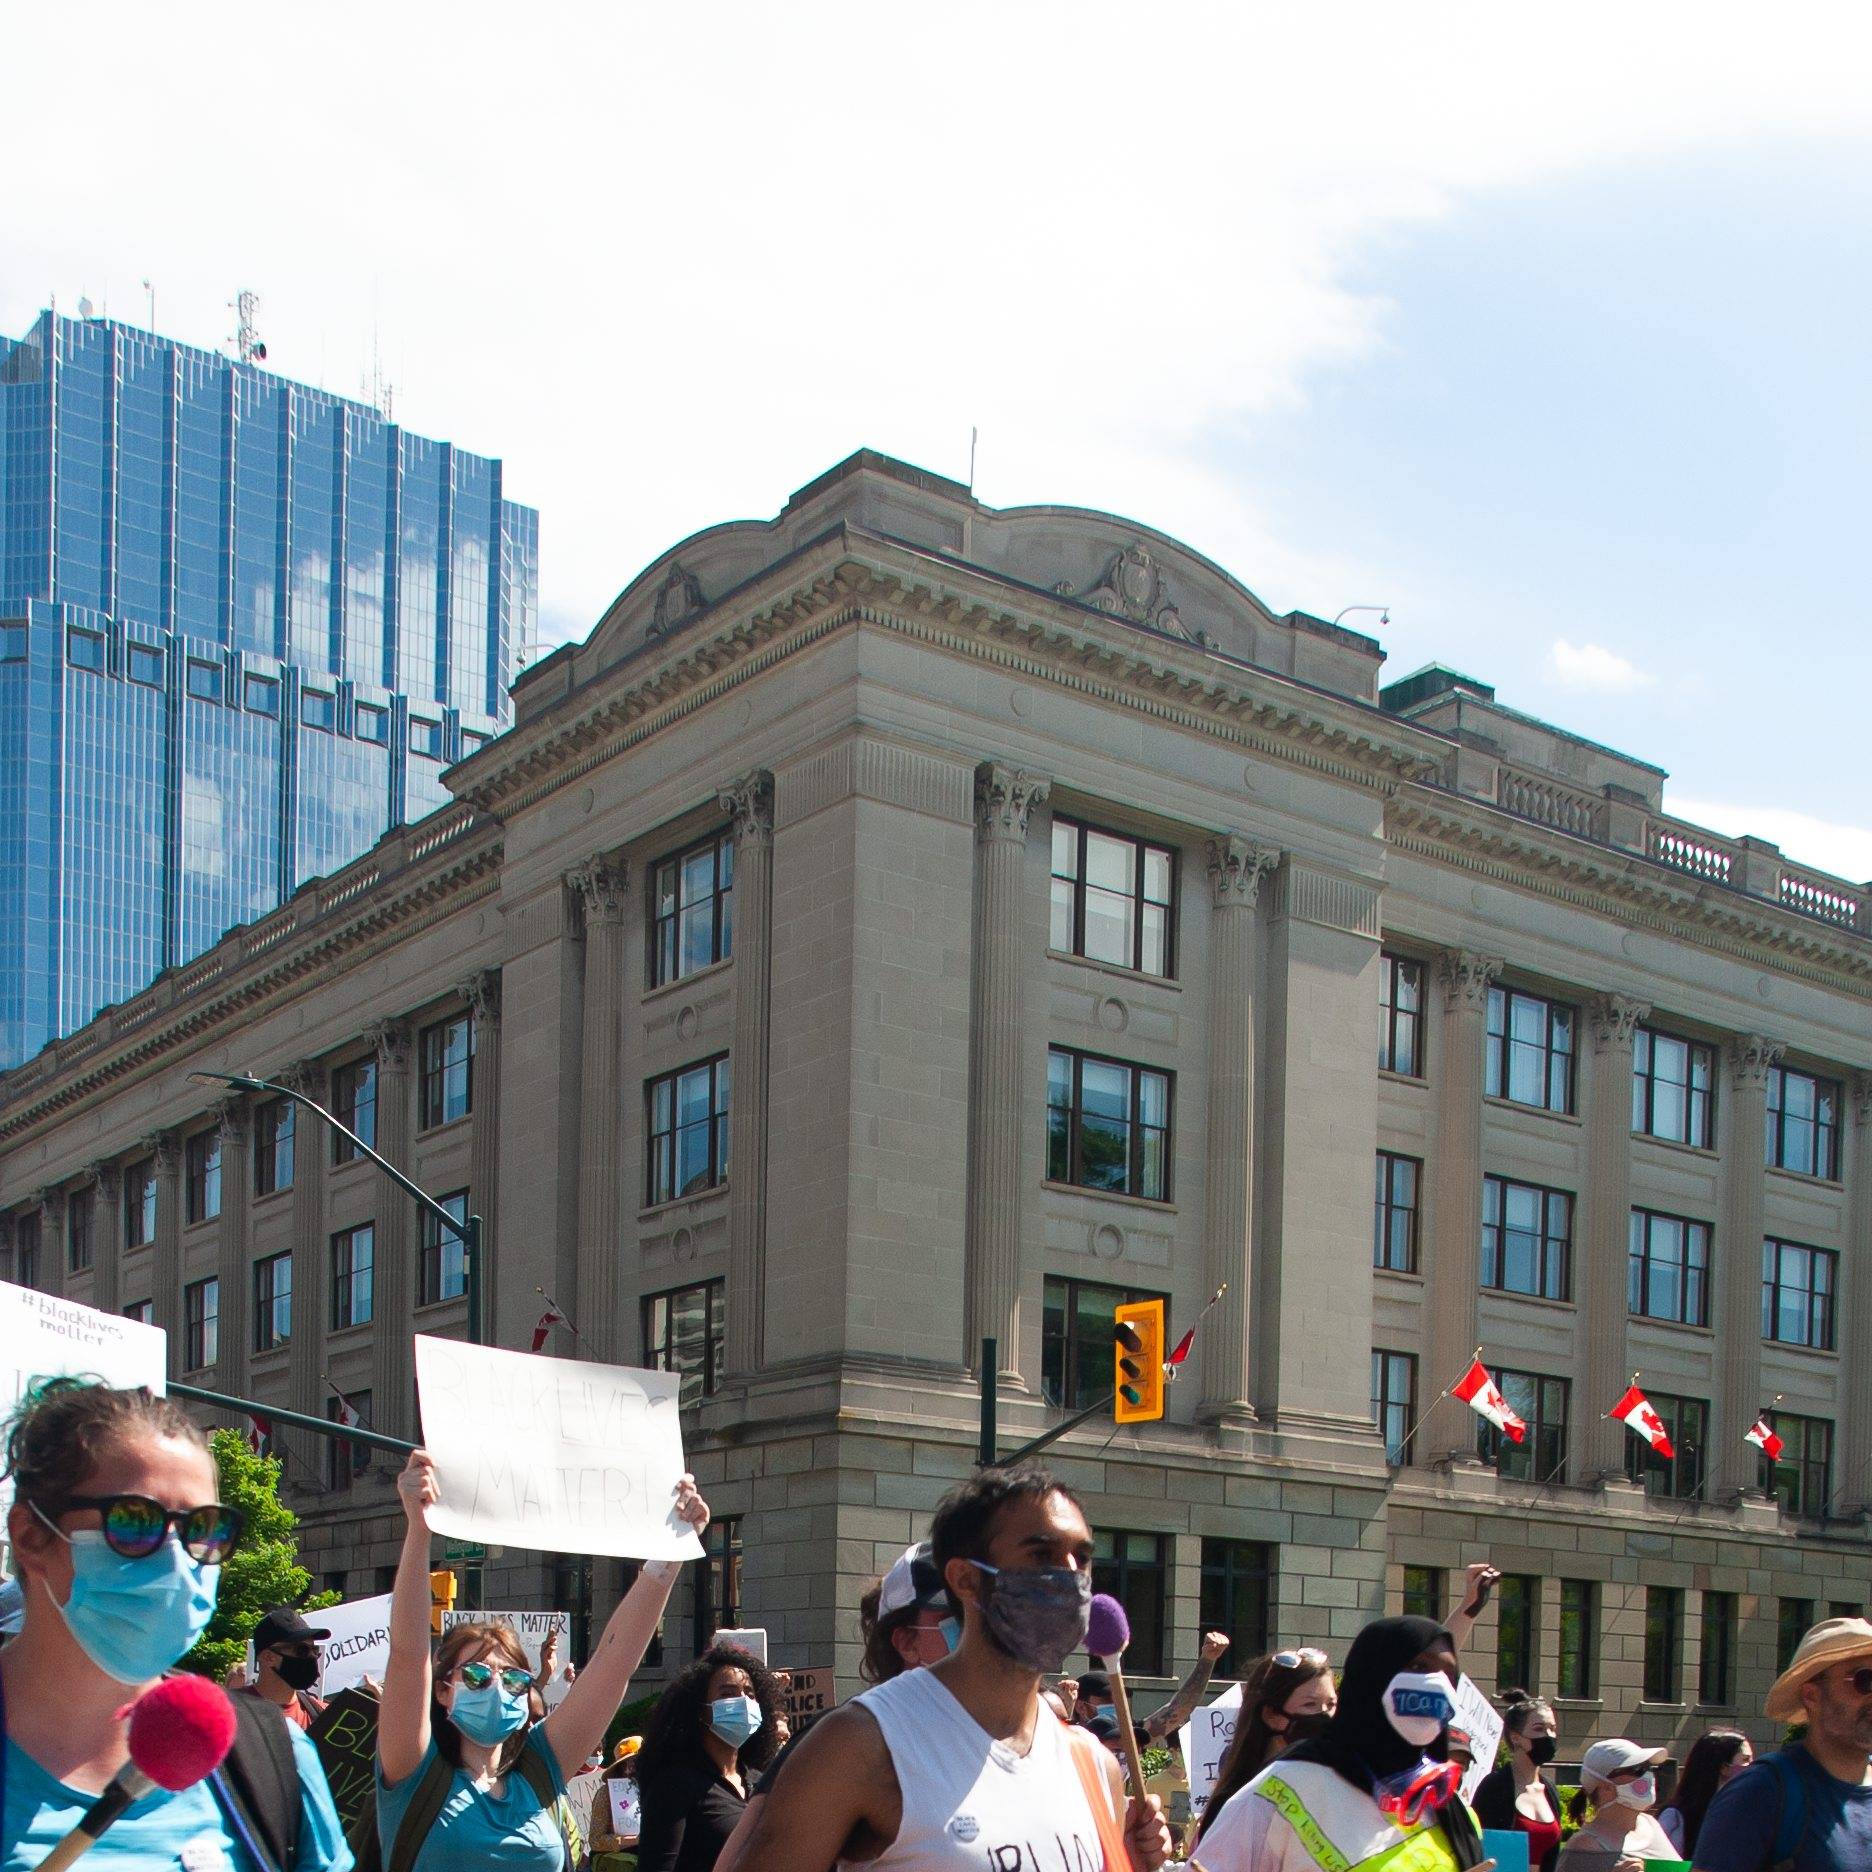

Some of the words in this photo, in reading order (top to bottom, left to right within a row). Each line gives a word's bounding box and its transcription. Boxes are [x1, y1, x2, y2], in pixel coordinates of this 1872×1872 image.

[555, 1376, 670, 1449] LIVES
[521, 1613, 568, 1634] MATTER
[325, 1625, 390, 1669] OLIDAR
